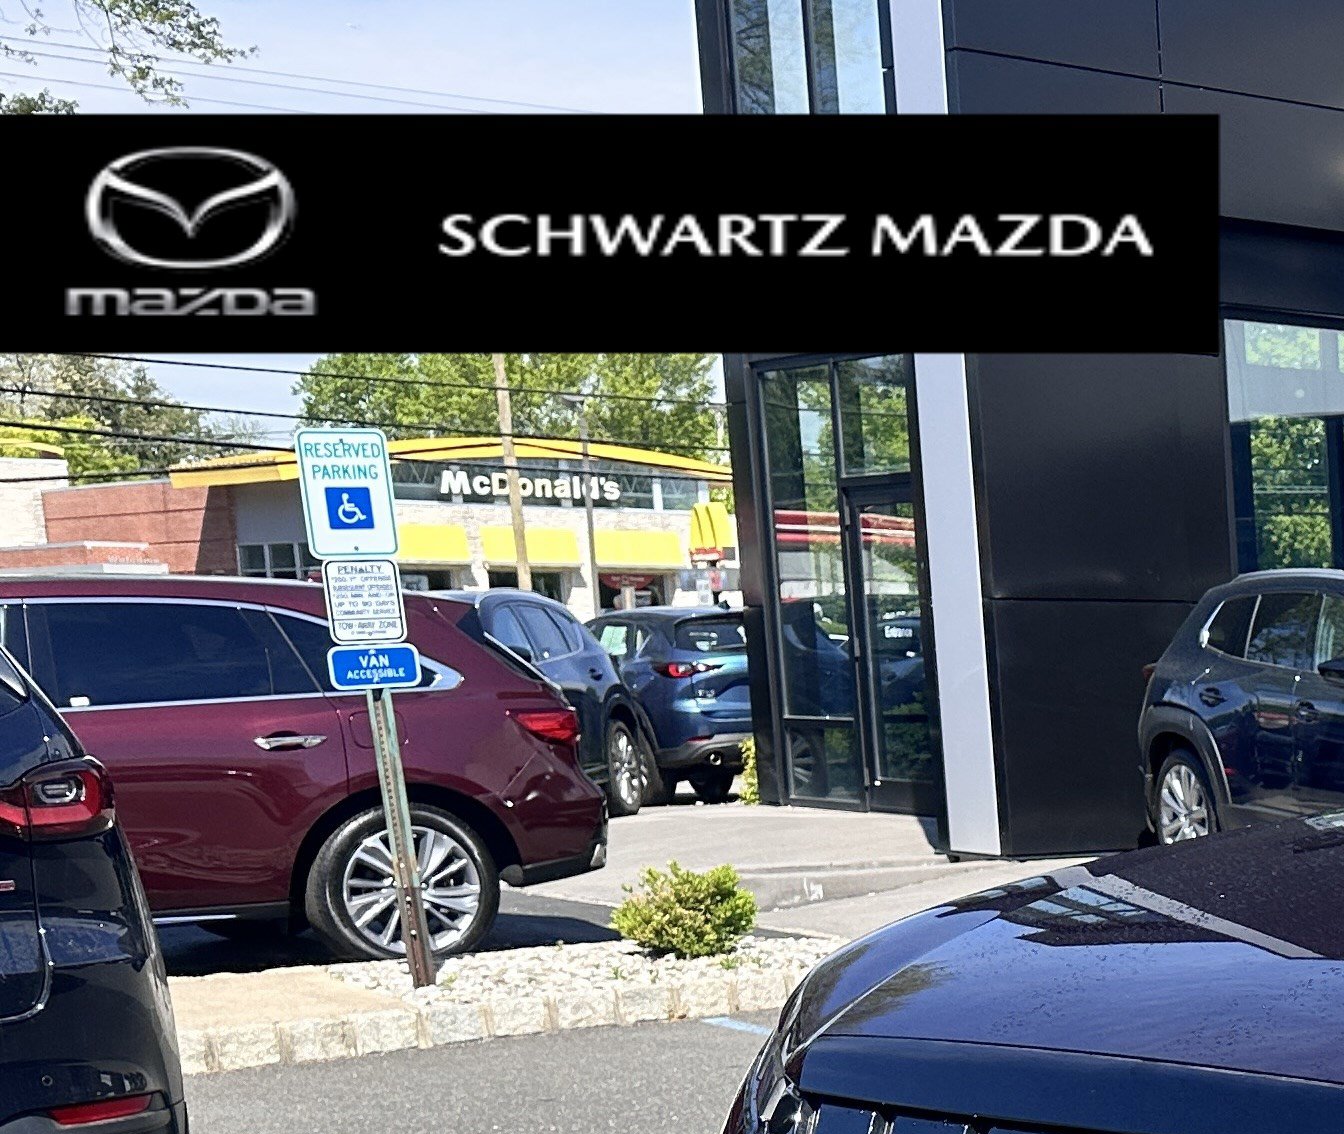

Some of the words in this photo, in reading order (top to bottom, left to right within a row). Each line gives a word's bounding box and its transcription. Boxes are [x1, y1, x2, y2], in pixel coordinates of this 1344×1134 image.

[304, 441, 381, 459] RESERVED
[312, 464, 379, 481] PARKING
[440, 470, 621, 500] McDonald's
[337, 565, 383, 574] PENALTY
[358, 654, 390, 668] VAN
[346, 667, 406, 681] ACCESSIBLE
